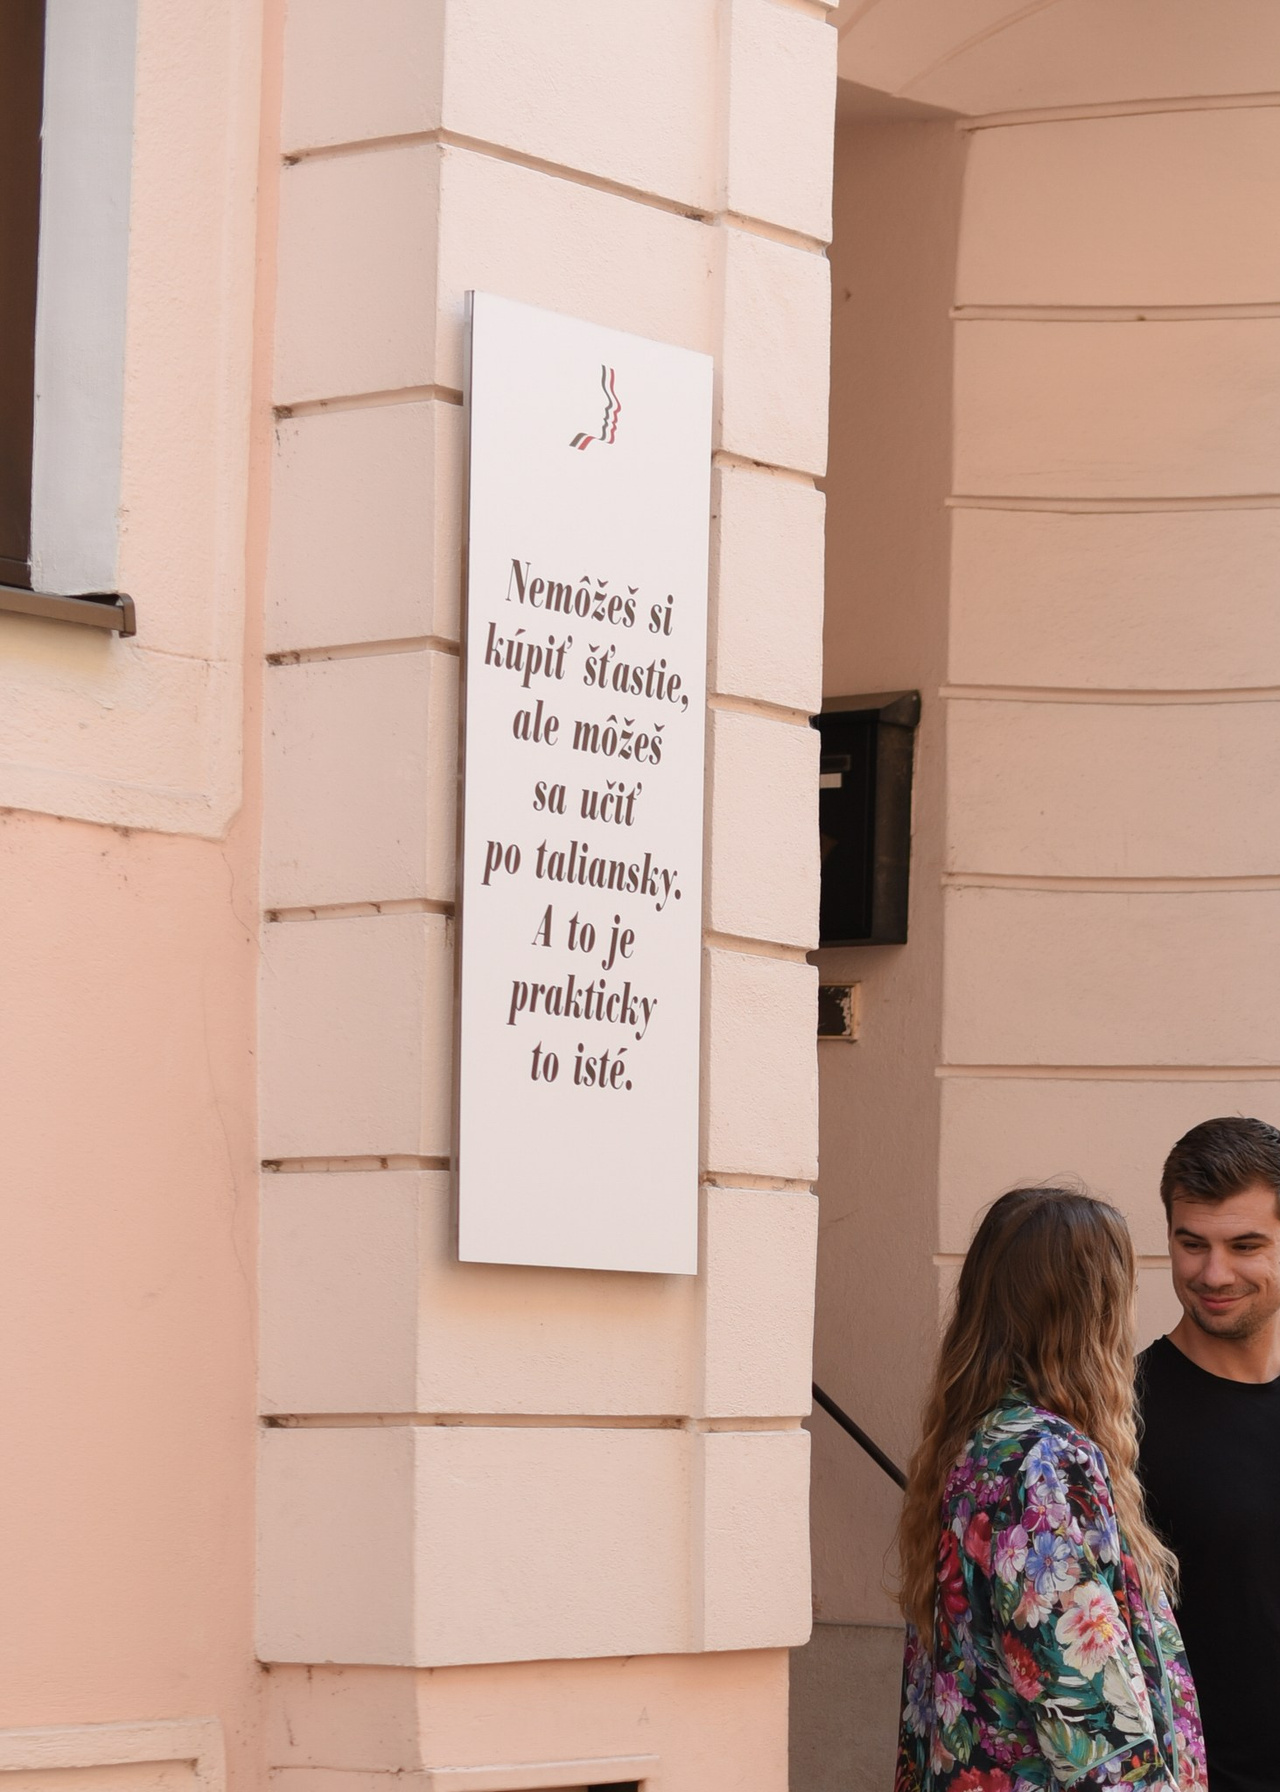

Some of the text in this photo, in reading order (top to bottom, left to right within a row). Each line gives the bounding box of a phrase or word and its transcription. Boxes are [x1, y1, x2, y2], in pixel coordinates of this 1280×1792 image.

[505, 558, 674, 637] Nemôžeš si
[484, 621, 689, 713] kúpiť šťastie,
[512, 699, 666, 766] ale môžeš
[533, 779, 642, 827] sa učiť
[481, 838, 681, 912] po taliansky.
[531, 904, 635, 971] A to je
[506, 974, 658, 1041] prakticky
[530, 1041, 633, 1091] to isté.
